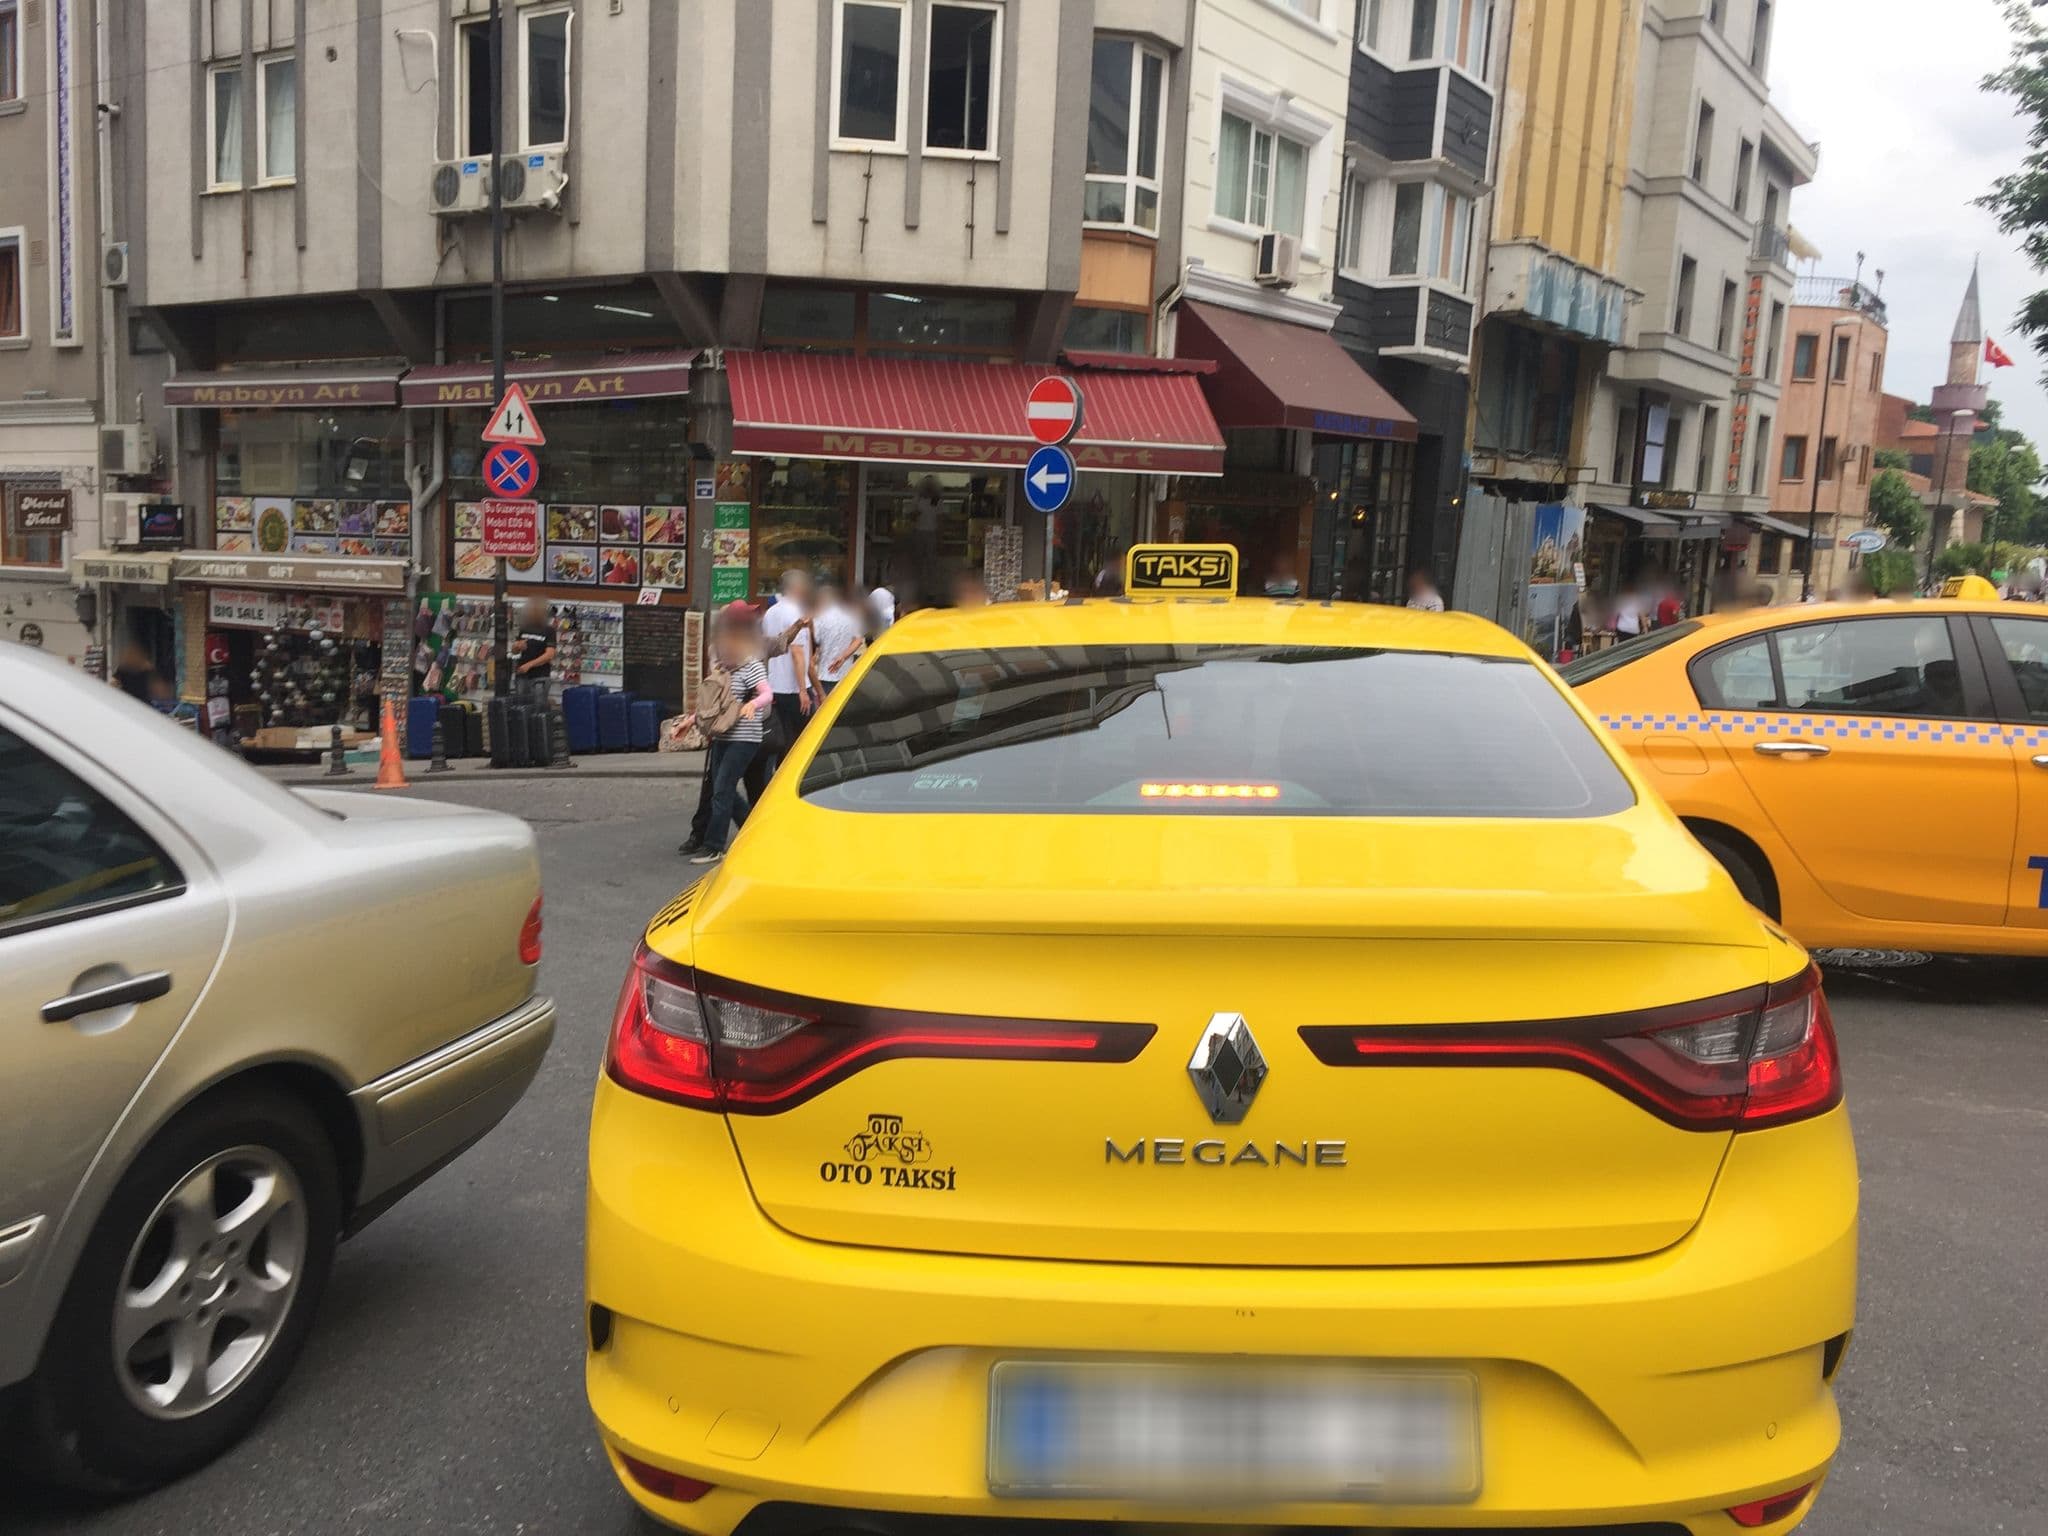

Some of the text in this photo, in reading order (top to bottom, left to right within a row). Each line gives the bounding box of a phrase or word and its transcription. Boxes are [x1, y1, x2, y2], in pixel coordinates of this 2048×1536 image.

[193, 383, 361, 403] Mabeyn Art
[438, 375, 625, 400] Mabyn Art
[822, 434, 1153, 466] Mabeyn Art
[494, 528, 526, 539] Denetim
[1139, 555, 1226, 577] TAKSİ
[868, 1114, 903, 1135] OTO
[1105, 1137, 1348, 1169] MEGANE
[820, 1162, 956, 1191] OTO TAKSİ
